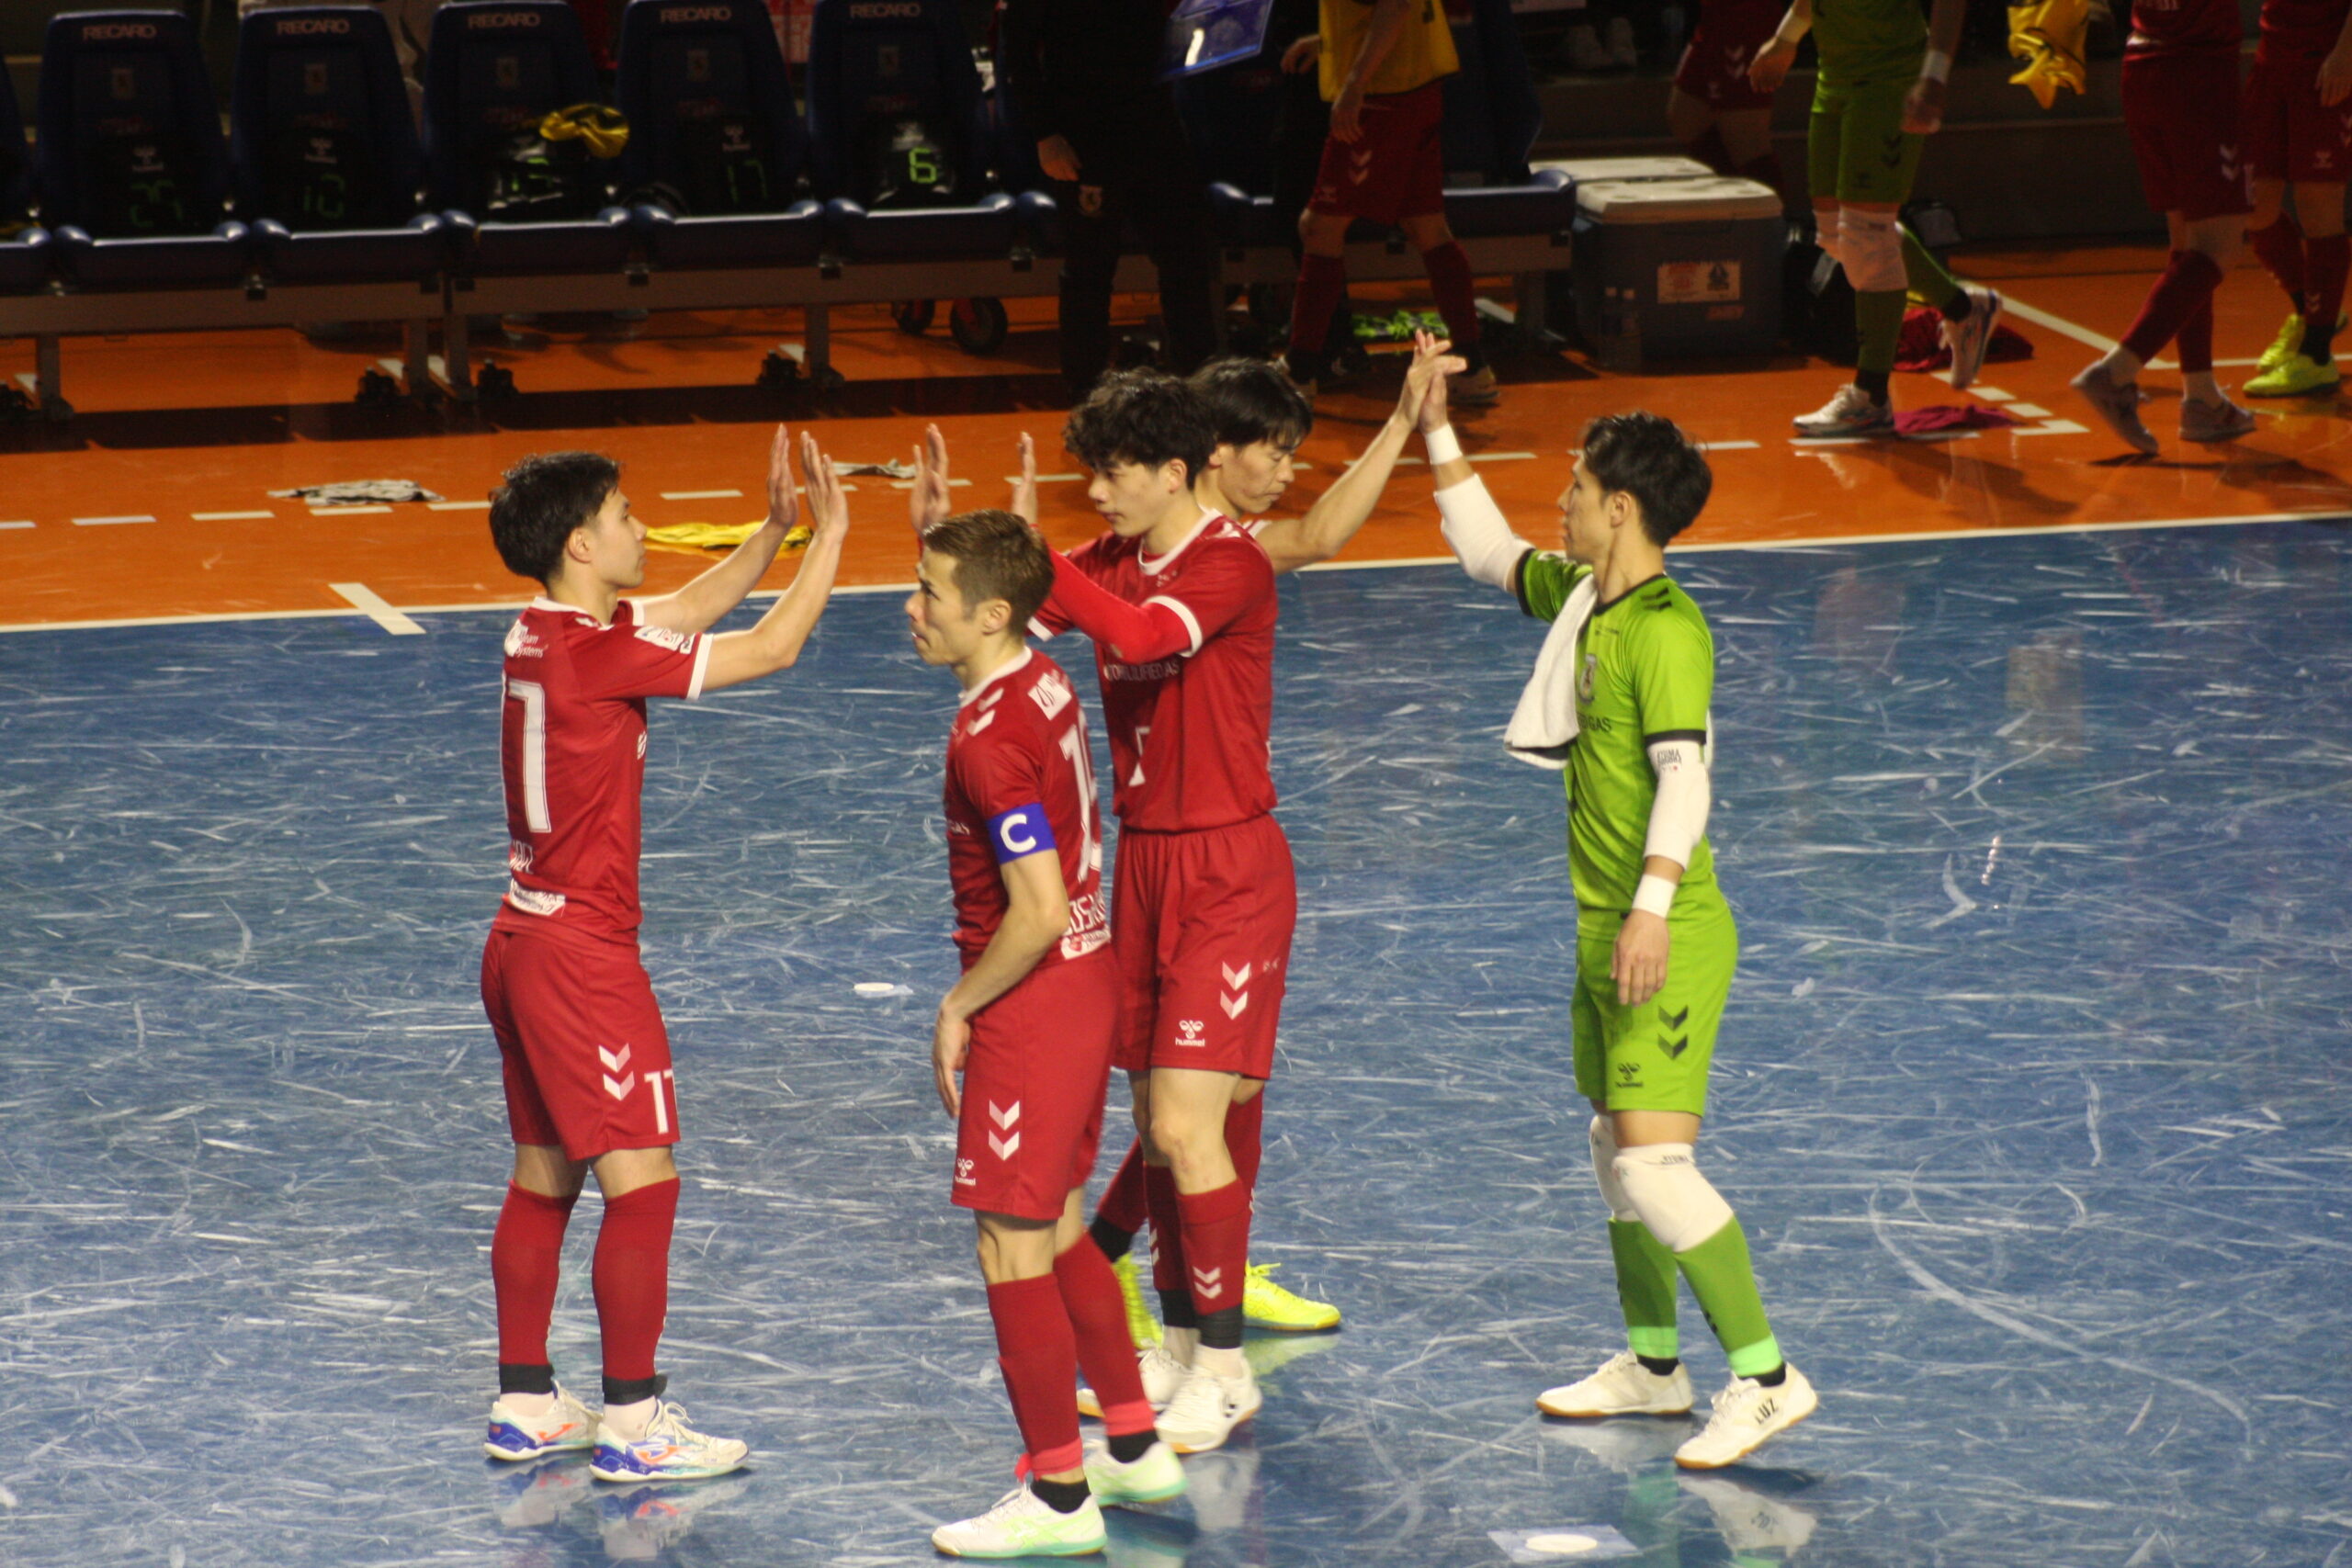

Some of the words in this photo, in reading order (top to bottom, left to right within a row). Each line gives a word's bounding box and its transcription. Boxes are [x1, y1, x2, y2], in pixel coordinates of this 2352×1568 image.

[659, 6, 732, 24] RECARO
[849, 2, 922, 19] RECARO
[276, 17, 351, 37] RECARO
[467, 12, 541, 30] RECARO
[82, 24, 158, 41] RECARO
[907, 146, 939, 185] 6
[1000, 813, 1037, 853] C
[1175, 1036, 1205, 1047] hummel
